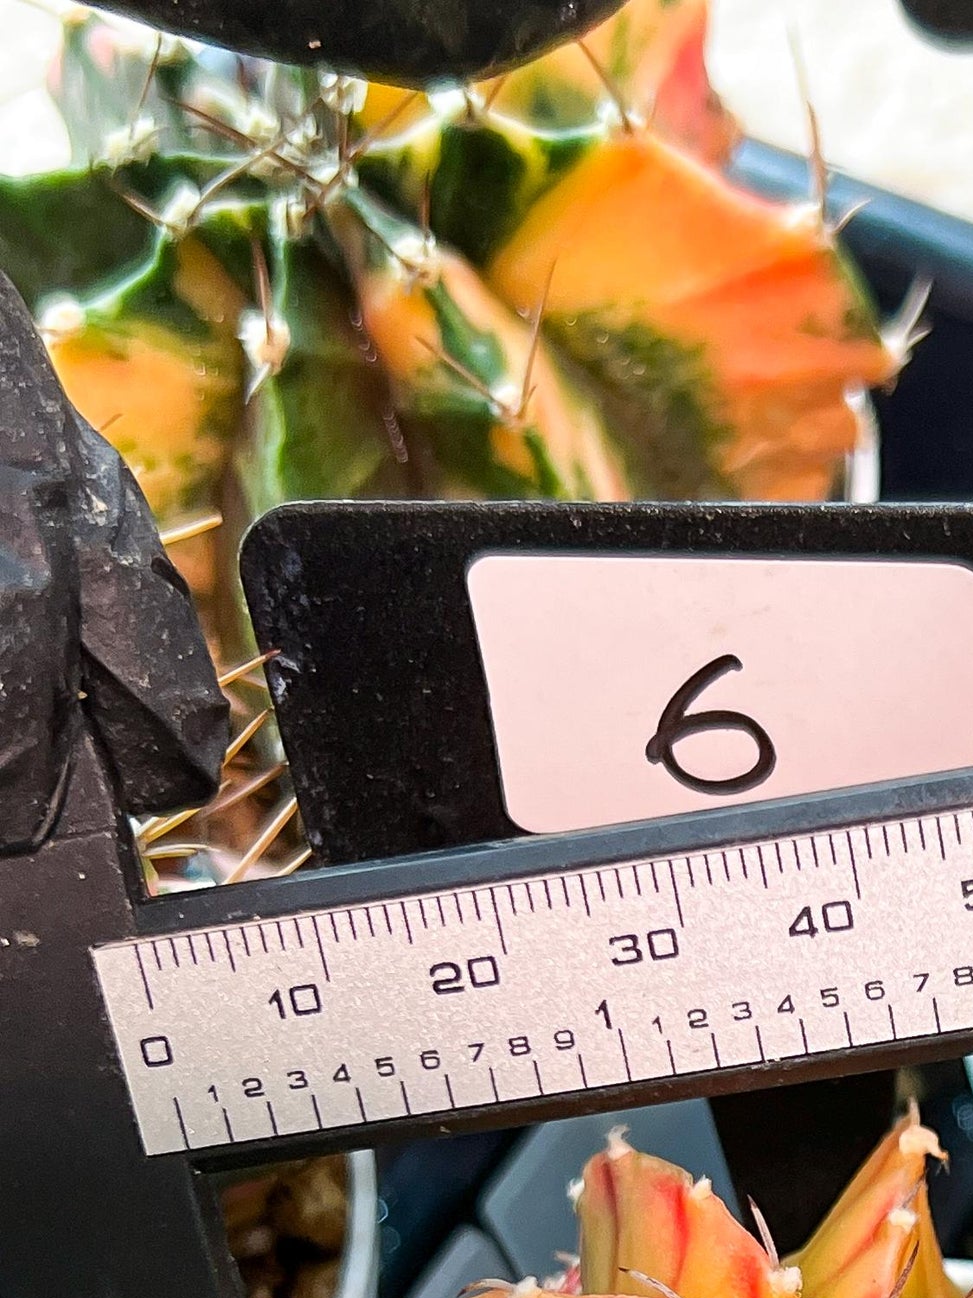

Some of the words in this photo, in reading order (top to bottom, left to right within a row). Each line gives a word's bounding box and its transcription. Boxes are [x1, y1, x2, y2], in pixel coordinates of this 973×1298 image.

[645, 653, 777, 795] 6
[139, 1035, 174, 1068] 0
[268, 983, 322, 1020] 10
[429, 955, 500, 995] 20
[608, 928, 679, 966] 30
[788, 900, 854, 938] 40
[207, 1084, 219, 1103] 1
[241, 1077, 265, 1098] 2
[286, 1070, 309, 1090] 3
[332, 1063, 352, 1083] 4
[374, 1056, 395, 1078] 5
[419, 1049, 441, 1070] 6
[467, 1042, 485, 1063] 7
[508, 1035, 532, 1057] 8
[553, 1029, 575, 1051] 9
[594, 999, 612, 1030] 1
[652, 1016, 663, 1034] 1
[687, 1008, 709, 1029] 2
[731, 1001, 752, 1021] 3
[777, 994, 795, 1014] 4
[820, 986, 840, 1008] 5
[864, 980, 886, 1001] 6
[913, 972, 930, 993] 7
